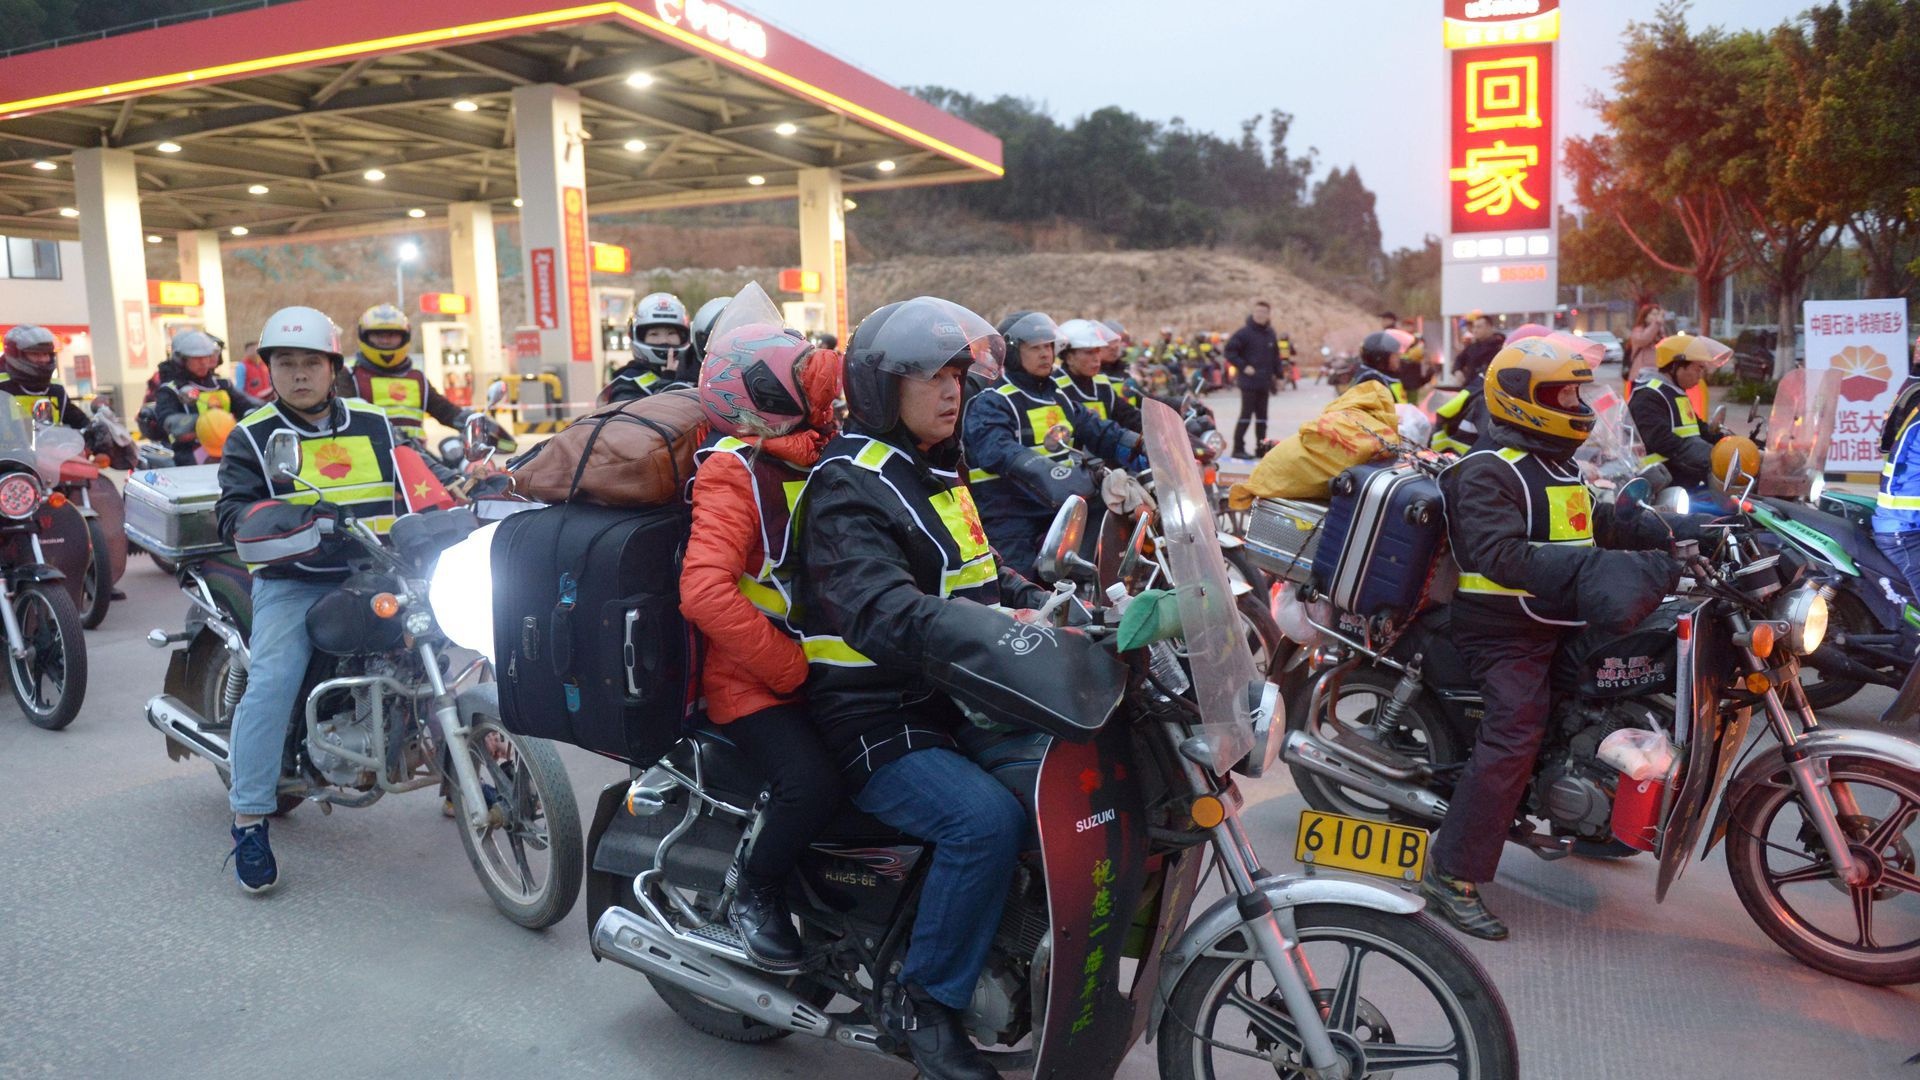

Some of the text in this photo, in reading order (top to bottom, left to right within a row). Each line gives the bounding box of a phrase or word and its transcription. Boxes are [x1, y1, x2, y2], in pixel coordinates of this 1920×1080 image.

[1457, 55, 1542, 216] 回家
[1597, 673, 1666, 688] 85161313
[1076, 808, 1115, 833] SUZUKI
[1304, 817, 1420, 868] 6101B
